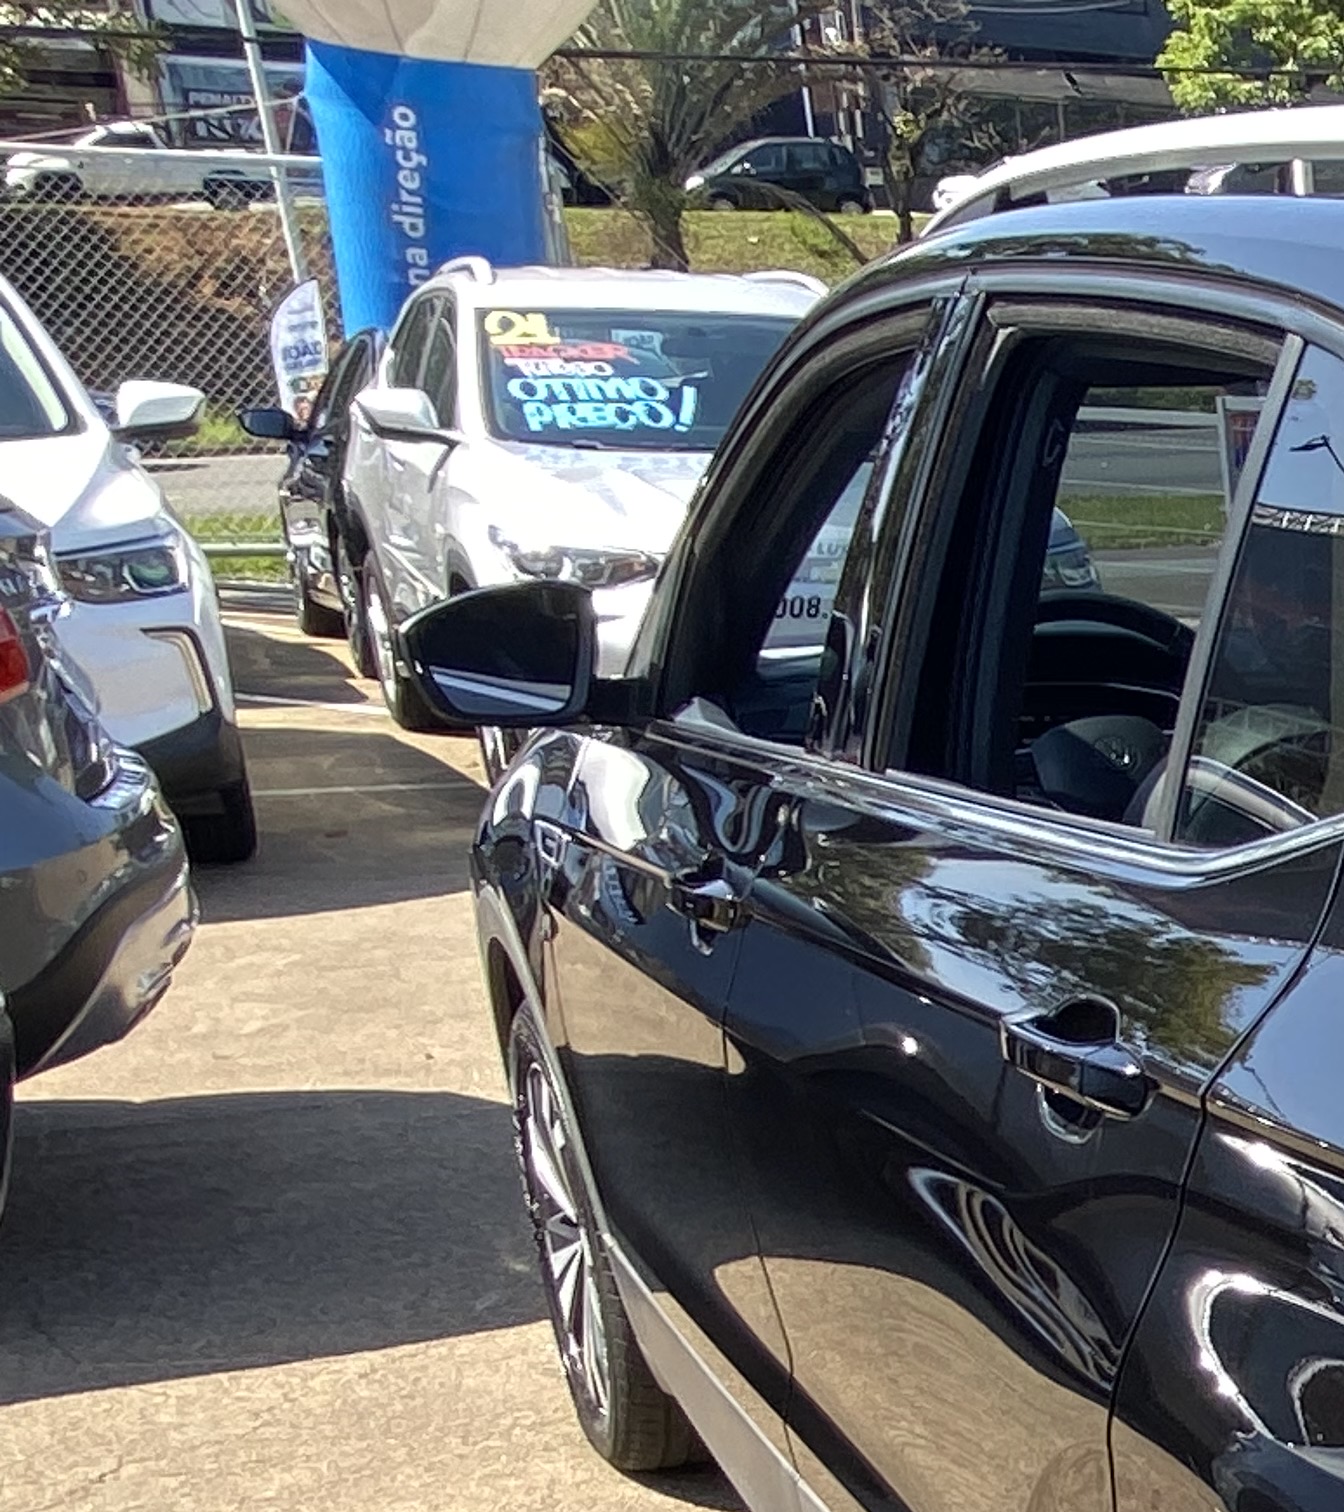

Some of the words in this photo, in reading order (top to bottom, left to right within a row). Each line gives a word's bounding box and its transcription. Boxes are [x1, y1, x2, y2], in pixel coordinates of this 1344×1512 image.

[385, 105, 427, 238] direção
[404, 252, 430, 287] na
[485, 310, 561, 345] 21
